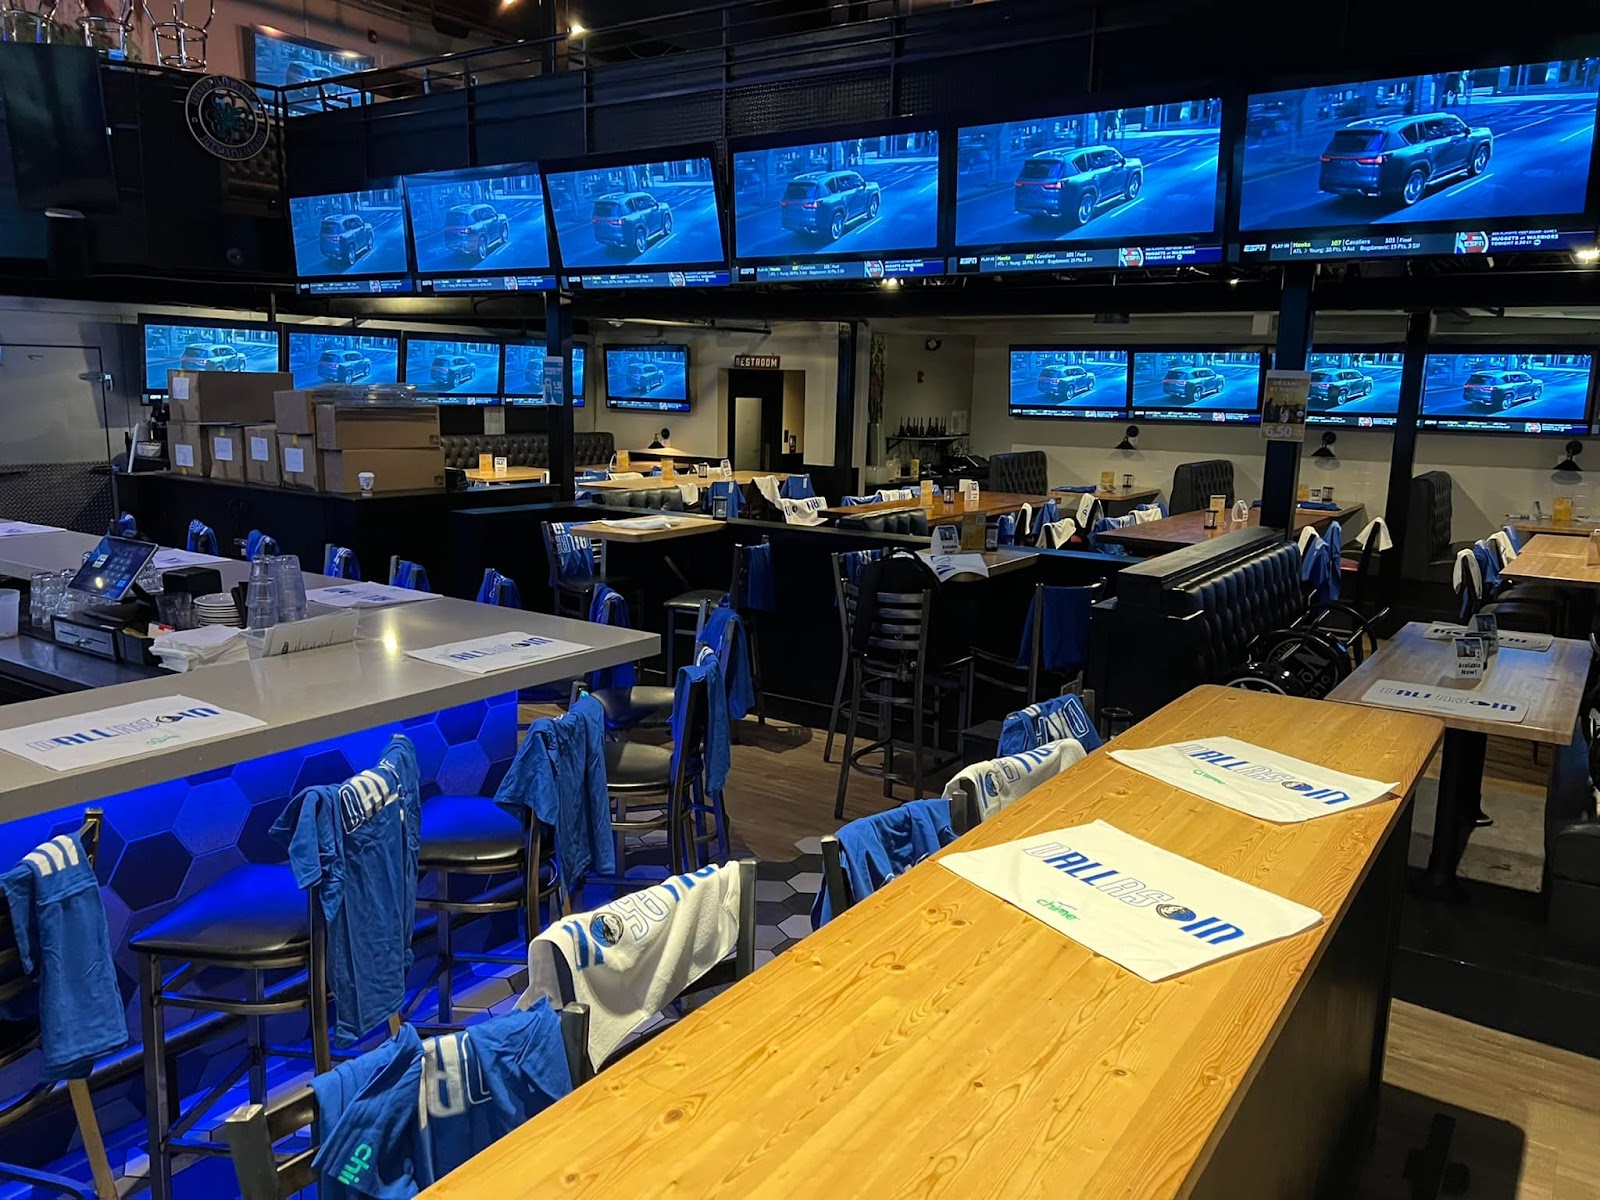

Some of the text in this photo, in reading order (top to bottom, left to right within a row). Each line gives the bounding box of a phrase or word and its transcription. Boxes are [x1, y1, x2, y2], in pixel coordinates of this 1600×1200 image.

[1243, 244, 1267, 252] ESPN
[735, 357, 778, 367] RESTROOM
[1301, 788, 1351, 805] IN
[1022, 841, 1245, 946] DALLAS IN
[1036, 898, 1080, 922] chime
